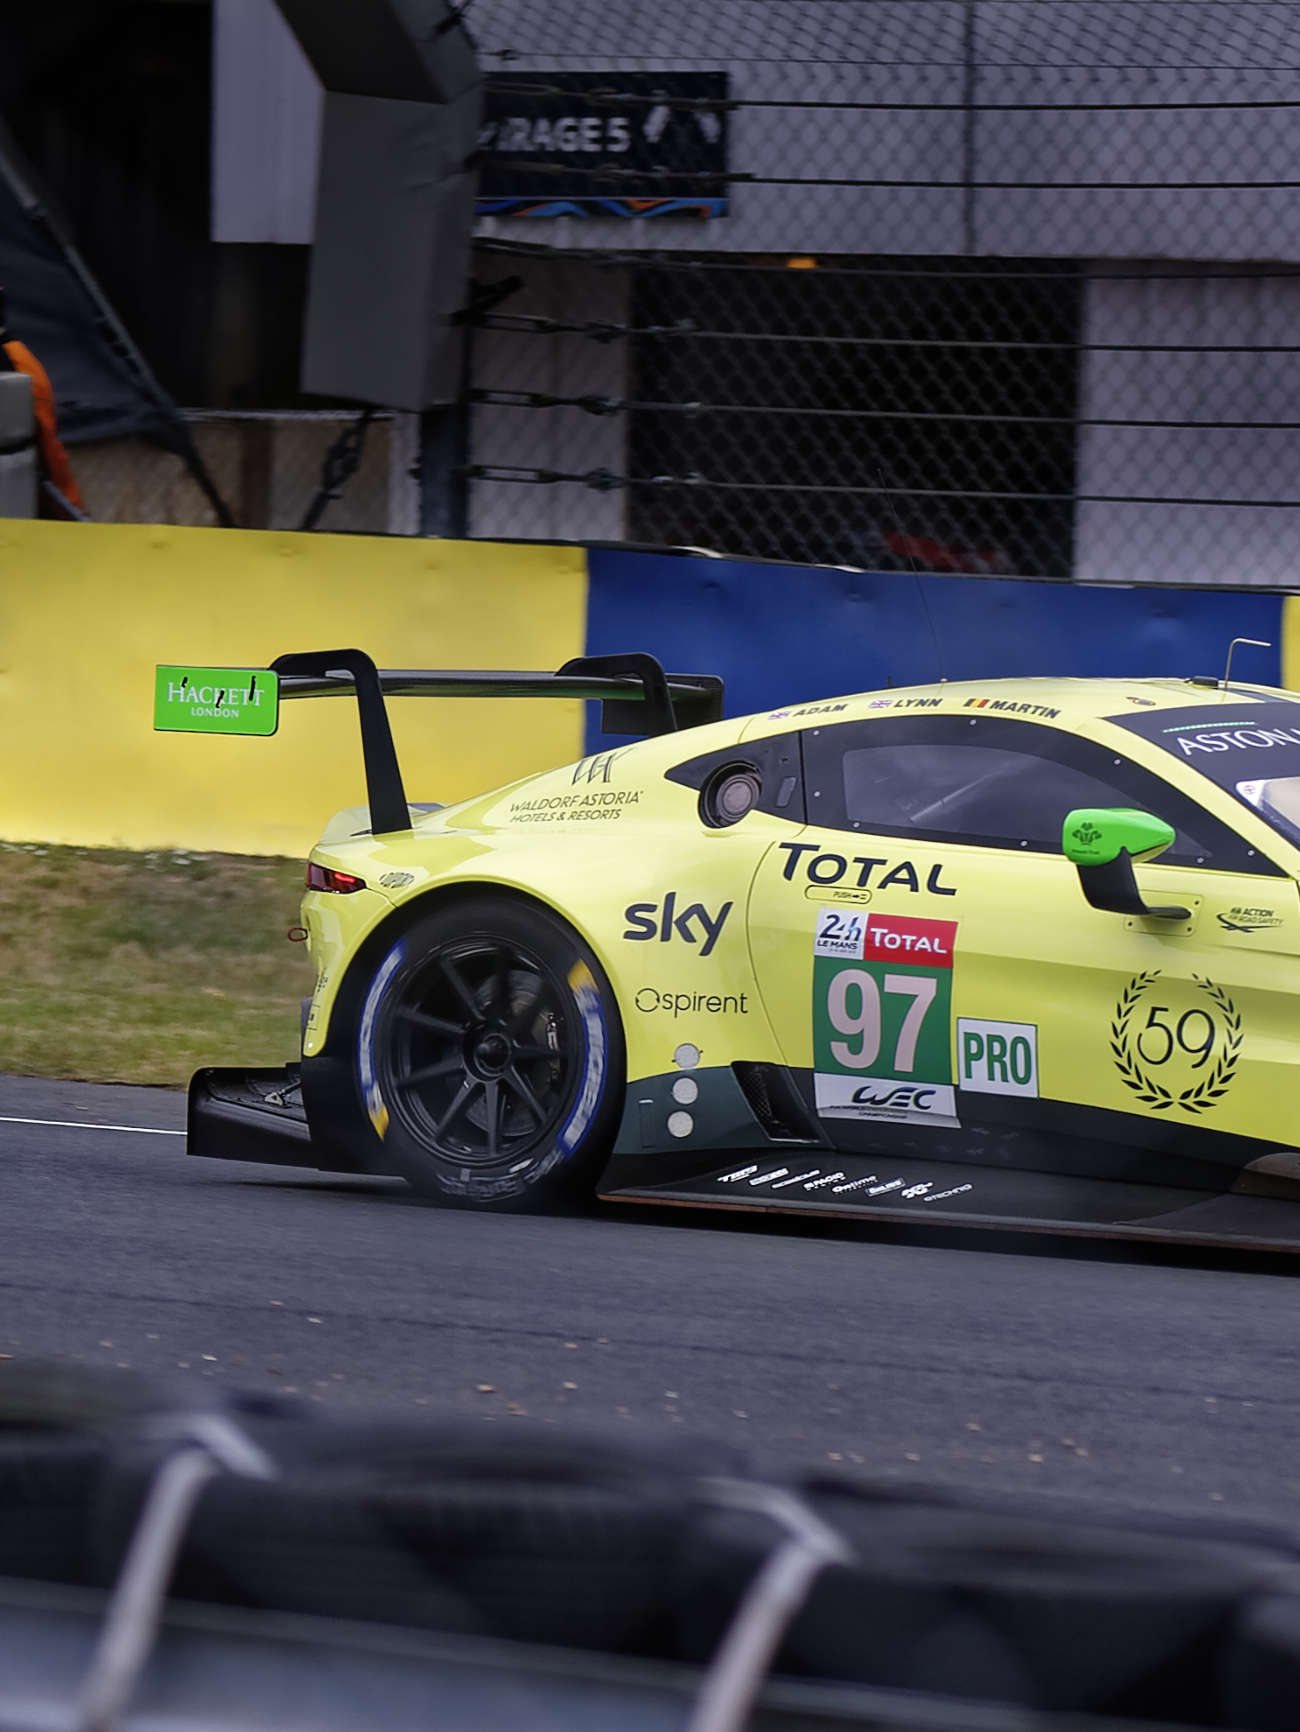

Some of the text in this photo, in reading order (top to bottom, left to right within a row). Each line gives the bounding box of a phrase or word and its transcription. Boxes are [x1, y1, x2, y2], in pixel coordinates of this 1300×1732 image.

[191, 707, 239, 718] LONDON
[792, 704, 848, 717] ADAM
[893, 698, 943, 709] LYNN
[988, 700, 1061, 719] MARTIN
[510, 791, 640, 812] WALDORF ASTORIA
[510, 809, 622, 823] HOTELS & RESORTS
[778, 842, 957, 896] TOTAL
[623, 891, 734, 957] sky
[830, 941, 858, 950] MANS
[870, 928, 947, 954] TOTAL
[827, 968, 937, 1073] 97
[1136, 1006, 1216, 1069] 59
[963, 1031, 1032, 1085] PRO
[852, 1086, 936, 1110] WEC
